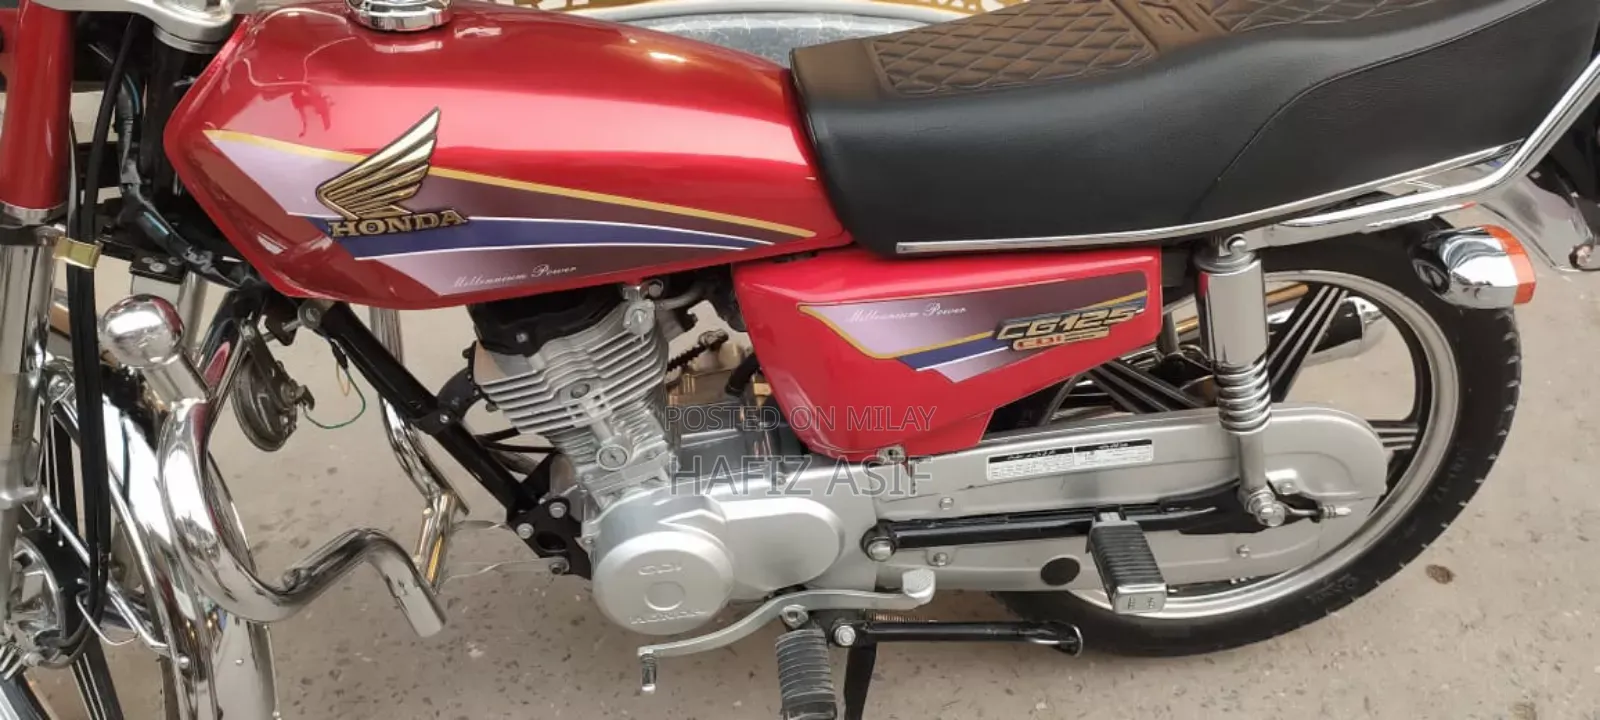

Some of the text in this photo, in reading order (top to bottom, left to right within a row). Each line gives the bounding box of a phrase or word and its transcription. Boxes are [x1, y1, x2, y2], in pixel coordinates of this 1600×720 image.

[328, 209, 467, 238] HONDA
[530, 263, 577, 278] Power
[922, 302, 966, 317] Power
[997, 307, 1138, 340] CG125
